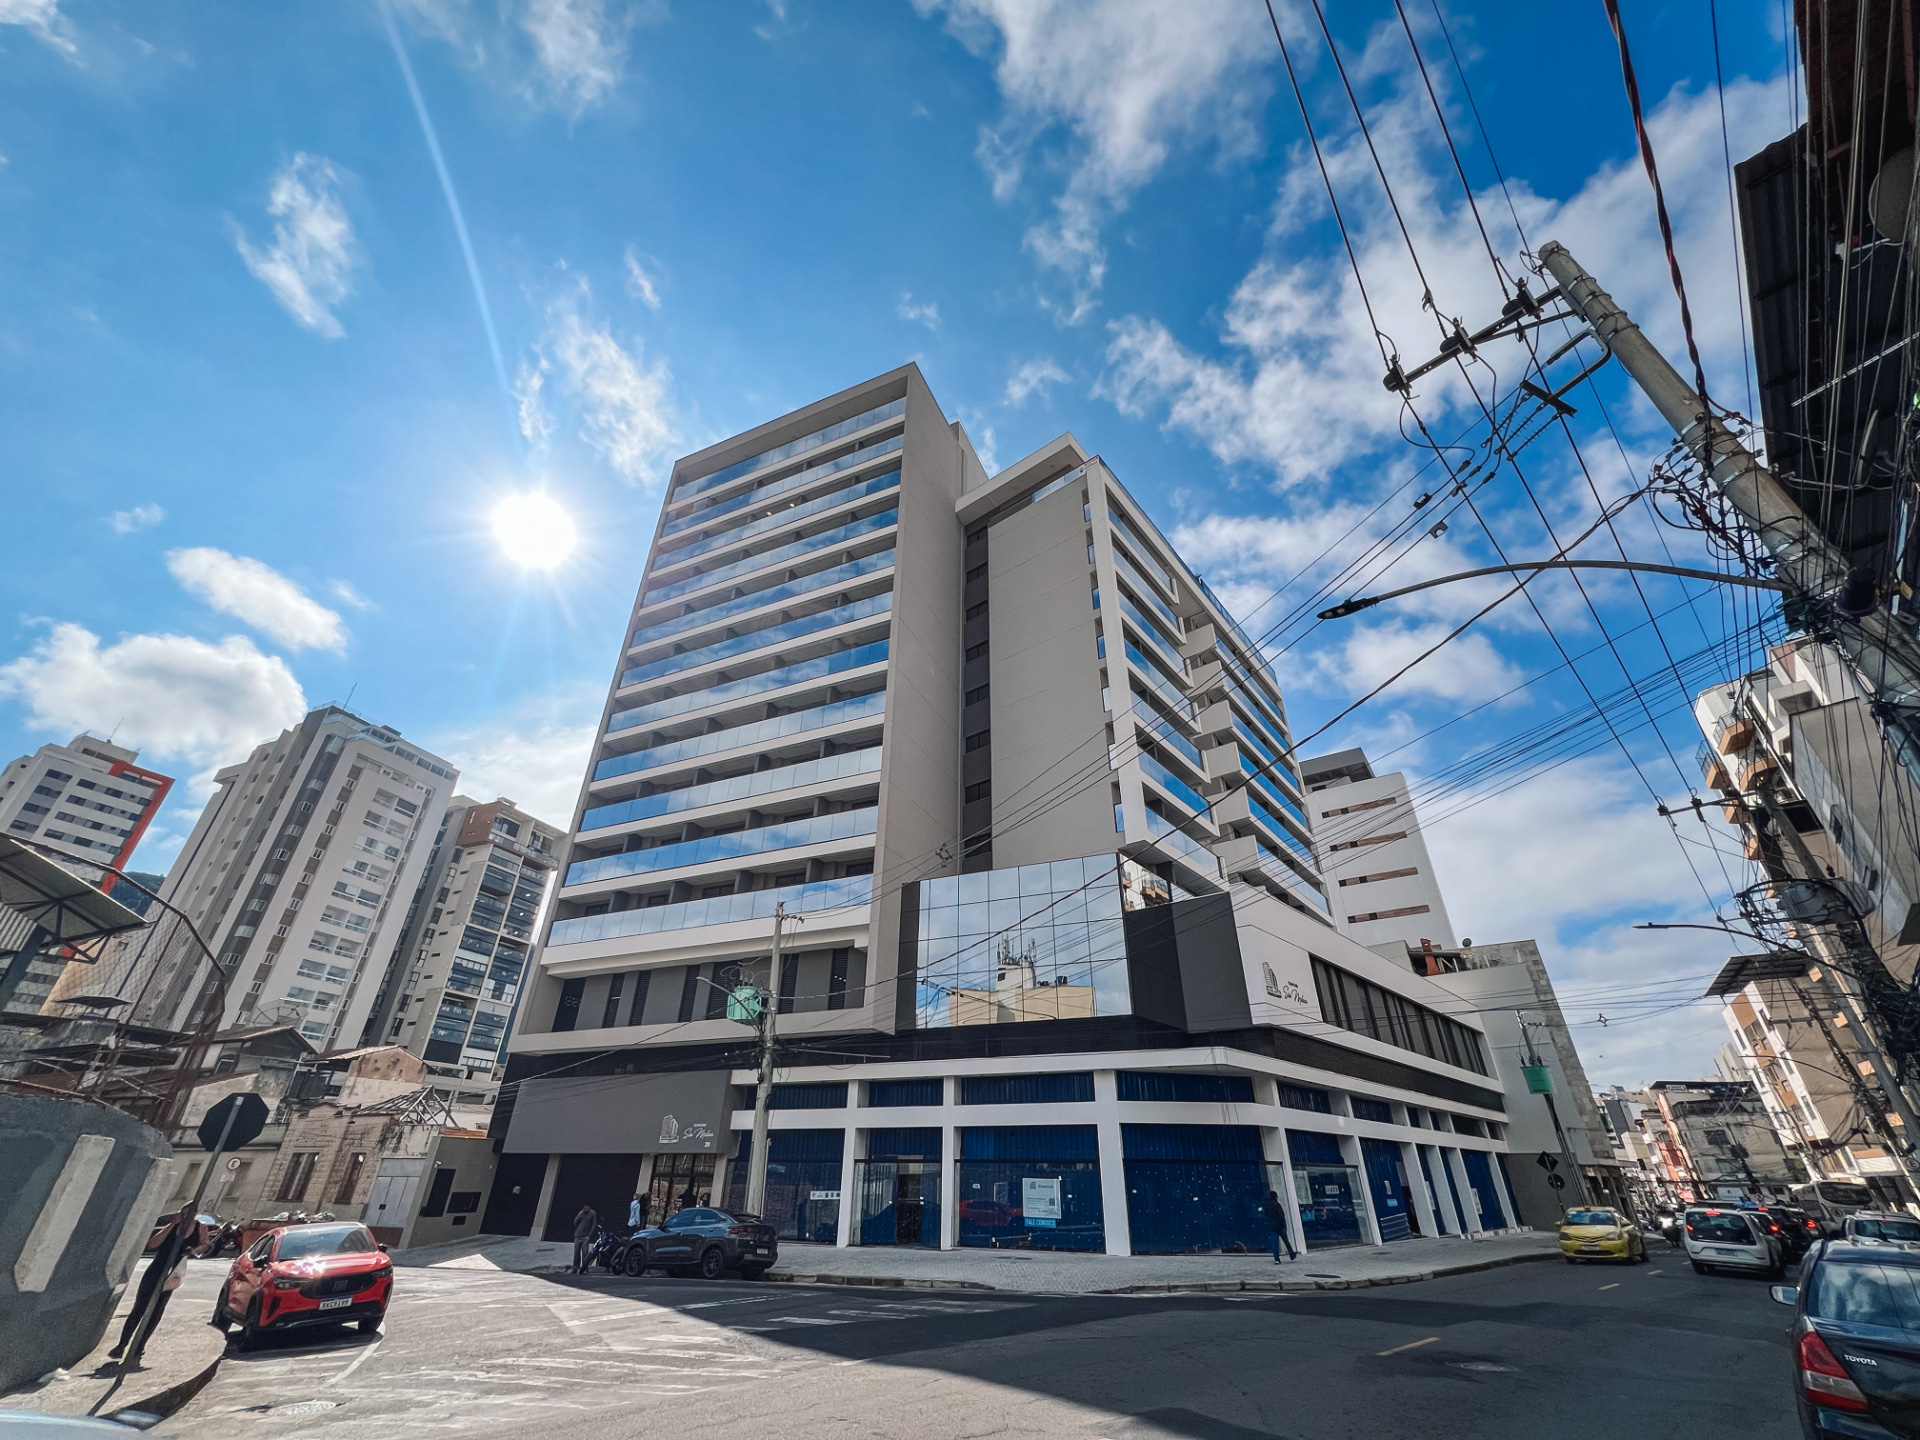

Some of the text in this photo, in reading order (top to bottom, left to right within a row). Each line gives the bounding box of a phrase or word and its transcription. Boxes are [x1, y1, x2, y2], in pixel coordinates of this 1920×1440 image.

[231, 1160, 238, 1168] E
[333, 1279, 349, 1292] FIAT
[1843, 1353, 1878, 1366] TOYOTA
